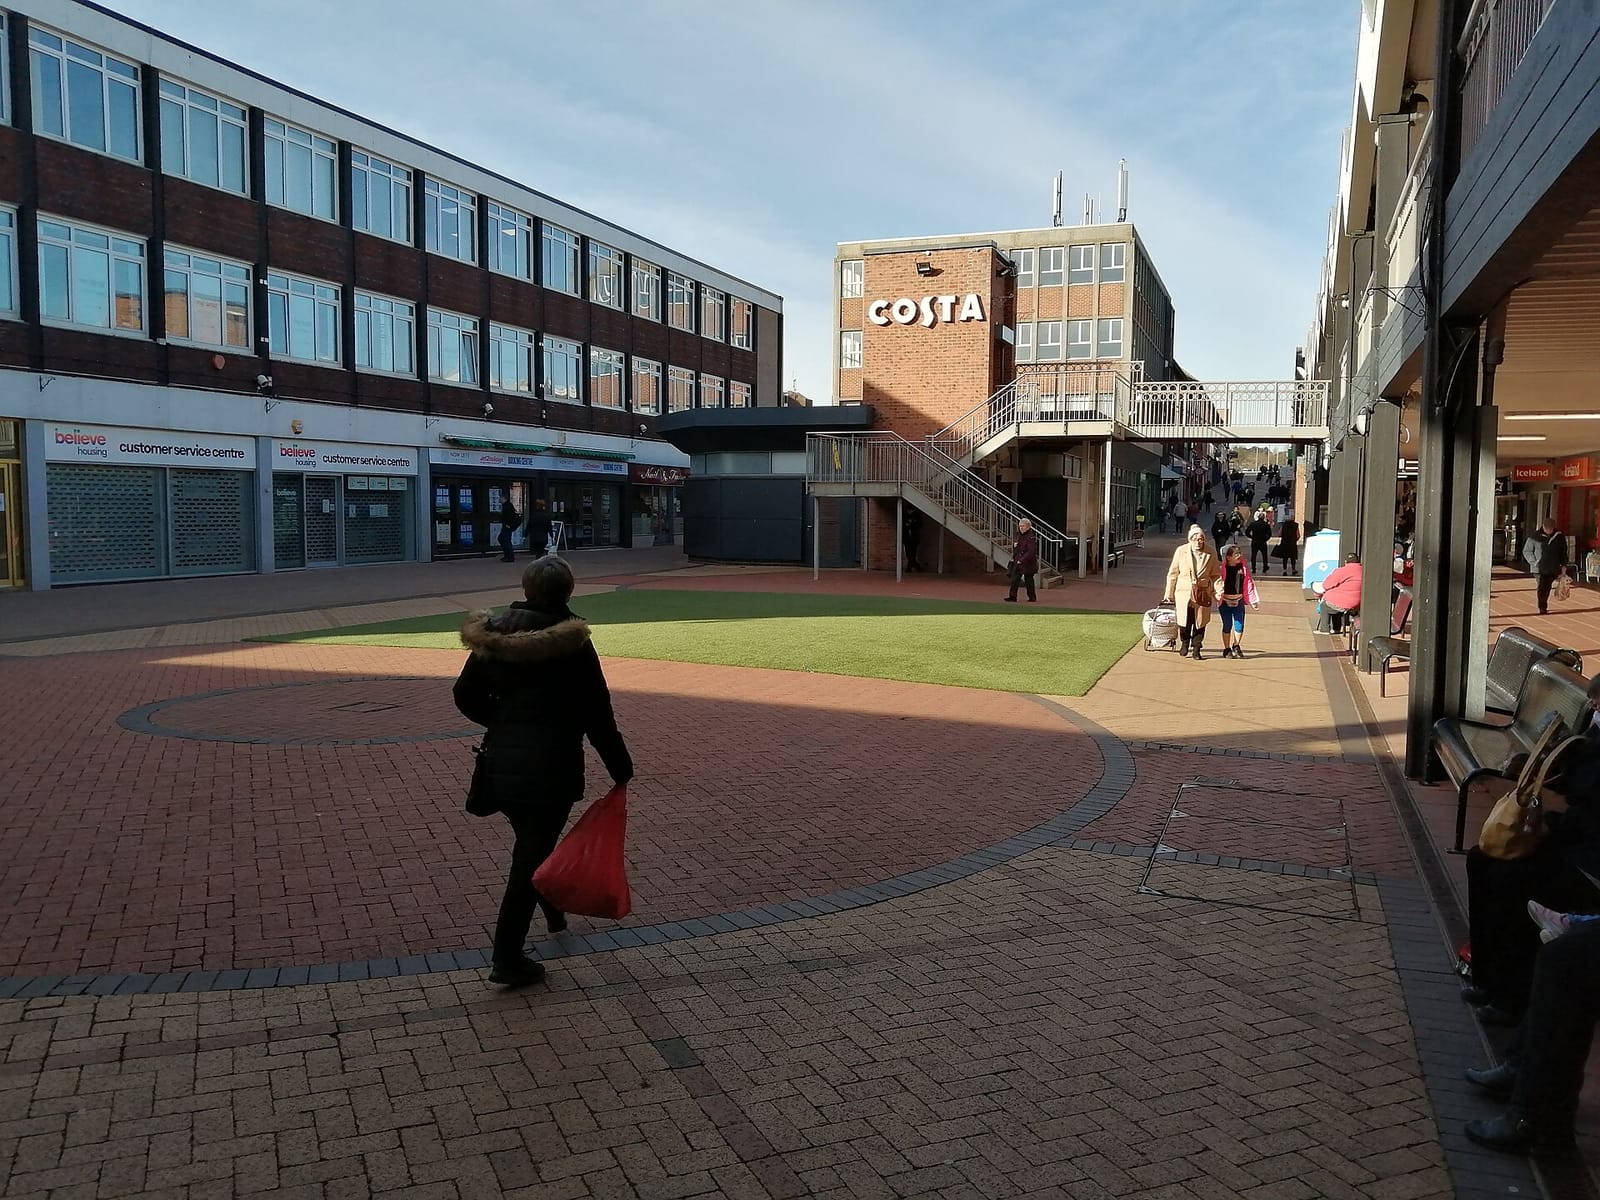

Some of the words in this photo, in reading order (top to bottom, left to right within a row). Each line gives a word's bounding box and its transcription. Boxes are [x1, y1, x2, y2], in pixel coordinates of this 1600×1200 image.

[868, 293, 986, 328] COSTA
[55, 428, 107, 446] believe
[77, 446, 108, 458] housing
[119, 442, 173, 455] customer
[174, 444, 212, 457] service
[212, 447, 245, 459] centre
[280, 443, 316, 458] believe
[295, 458, 317, 468] housing
[322, 453, 359, 465] customer
[360, 455, 387, 466] service
[387, 457, 410, 467] centre
[1516, 468, 1549, 477] Iceland
